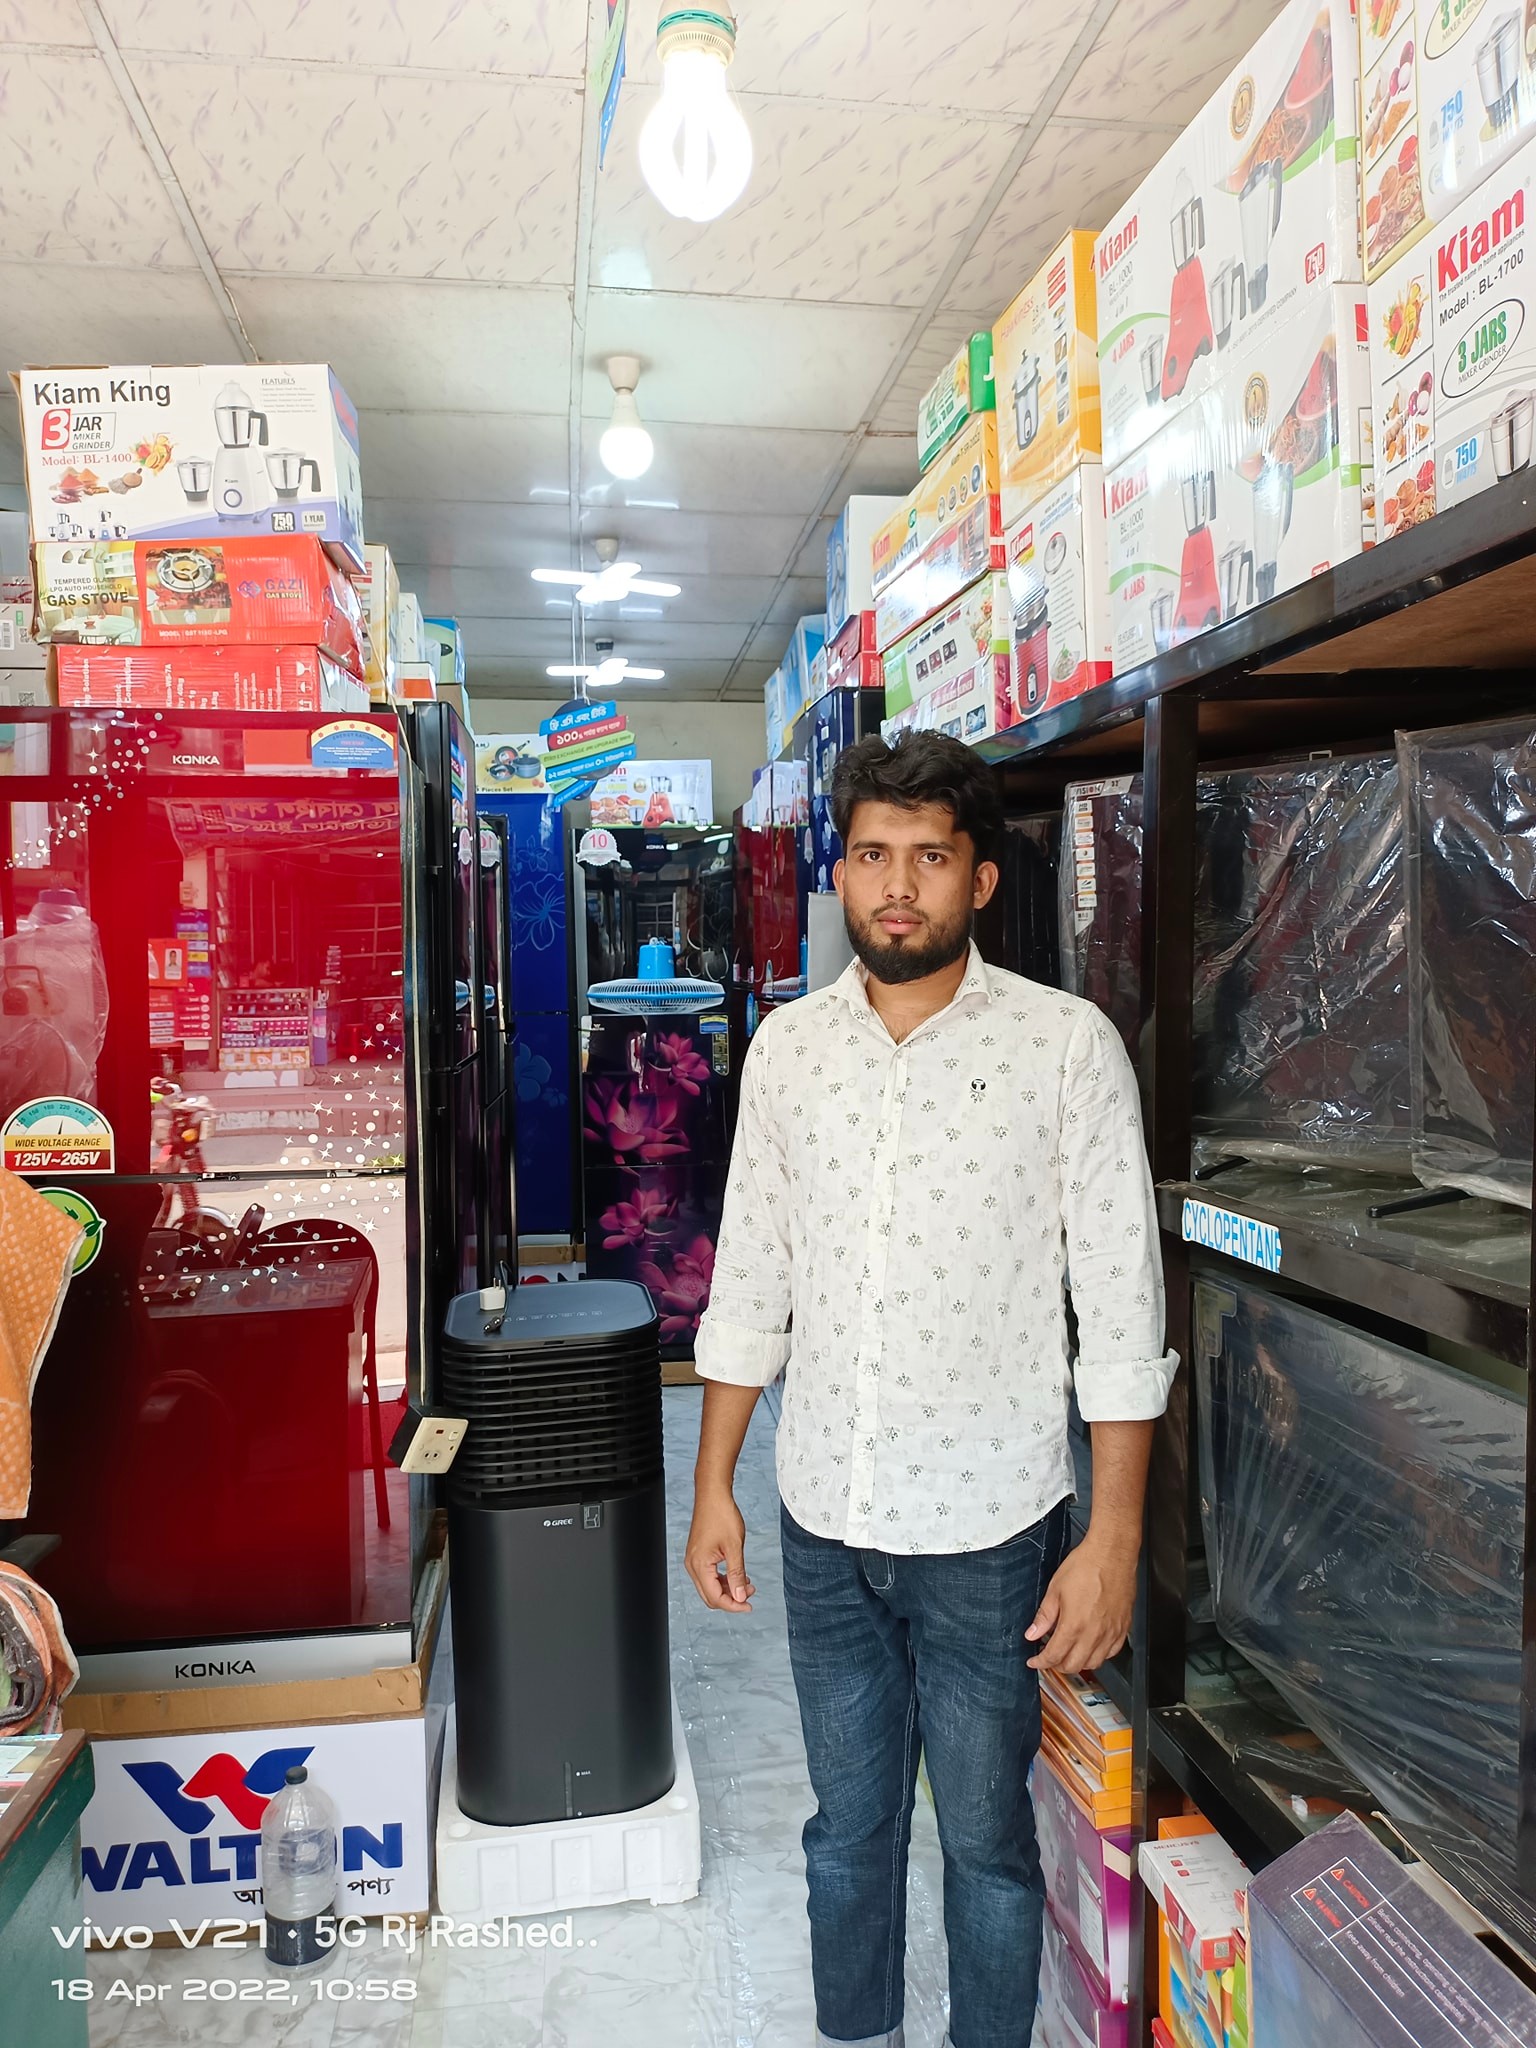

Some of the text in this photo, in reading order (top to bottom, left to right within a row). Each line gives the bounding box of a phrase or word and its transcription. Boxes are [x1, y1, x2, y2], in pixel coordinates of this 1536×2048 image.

[1441, 90, 1462, 128] 750
[1099, 214, 1138, 279] Kiam
[1438, 189, 1524, 292] Kiam
[1448, 280, 1464, 296] trusted
[1464, 269, 1477, 281] name
[1483, 253, 1496, 268] home
[1498, 229, 1525, 255] appliances
[1440, 292, 1469, 326] Model
[1479, 248, 1524, 296] BL-1700
[1357, 344, 1369, 352] The
[1458, 310, 1507, 374] 3 JARS
[1458, 345, 1507, 384] MIXER GRINDER
[34, 380, 170, 407] Kiam King
[45, 410, 70, 447] 3
[72, 416, 102, 432] JAR
[73, 432, 102, 440] MIXER
[72, 441, 111, 450] GRINDER
[1456, 437, 1477, 470] 750
[42, 453, 132, 466] Model: BL-1400
[1110, 464, 1149, 514] Kiam
[310, 514, 325, 522] YEAR
[1120, 508, 1144, 535] BL-1000
[1010, 526, 1032, 560] Kiam
[64, 584, 82, 592] AUTO
[265, 578, 302, 590] GAZI
[1130, 576, 1145, 598] JARS
[47, 592, 129, 606] GAS STOVE
[124, 657, 132, 704] Computing
[172, 755, 220, 766] KONKA
[556, 746, 586, 759] EXCHANGE
[594, 738, 618, 749] UPGRADE
[589, 834, 608, 848] 10
[74, 1108, 86, 1116] 240
[14, 1138, 101, 1148] WIDE VOLTAGE RANGE
[14, 1151, 101, 1167] 125V~265V
[552, 1518, 574, 1526] GREE
[175, 1660, 256, 1679] KONKA
[81, 1823, 403, 1893] WALTON
[347, 1878, 396, 1896] পণ্য
[1342, 1879, 1370, 1908] CAUTION
[1367, 1916, 1384, 1936] please
[1383, 1934, 1396, 1948] read
[1396, 1946, 1406, 1958] the
[1404, 1956, 1436, 1991] instructions
[1376, 1908, 1394, 1926] Before
[1394, 1925, 1422, 1960] connecting,
[1422, 1958, 1450, 1988] operating
[1345, 1930, 1405, 1998] Keep away from children
